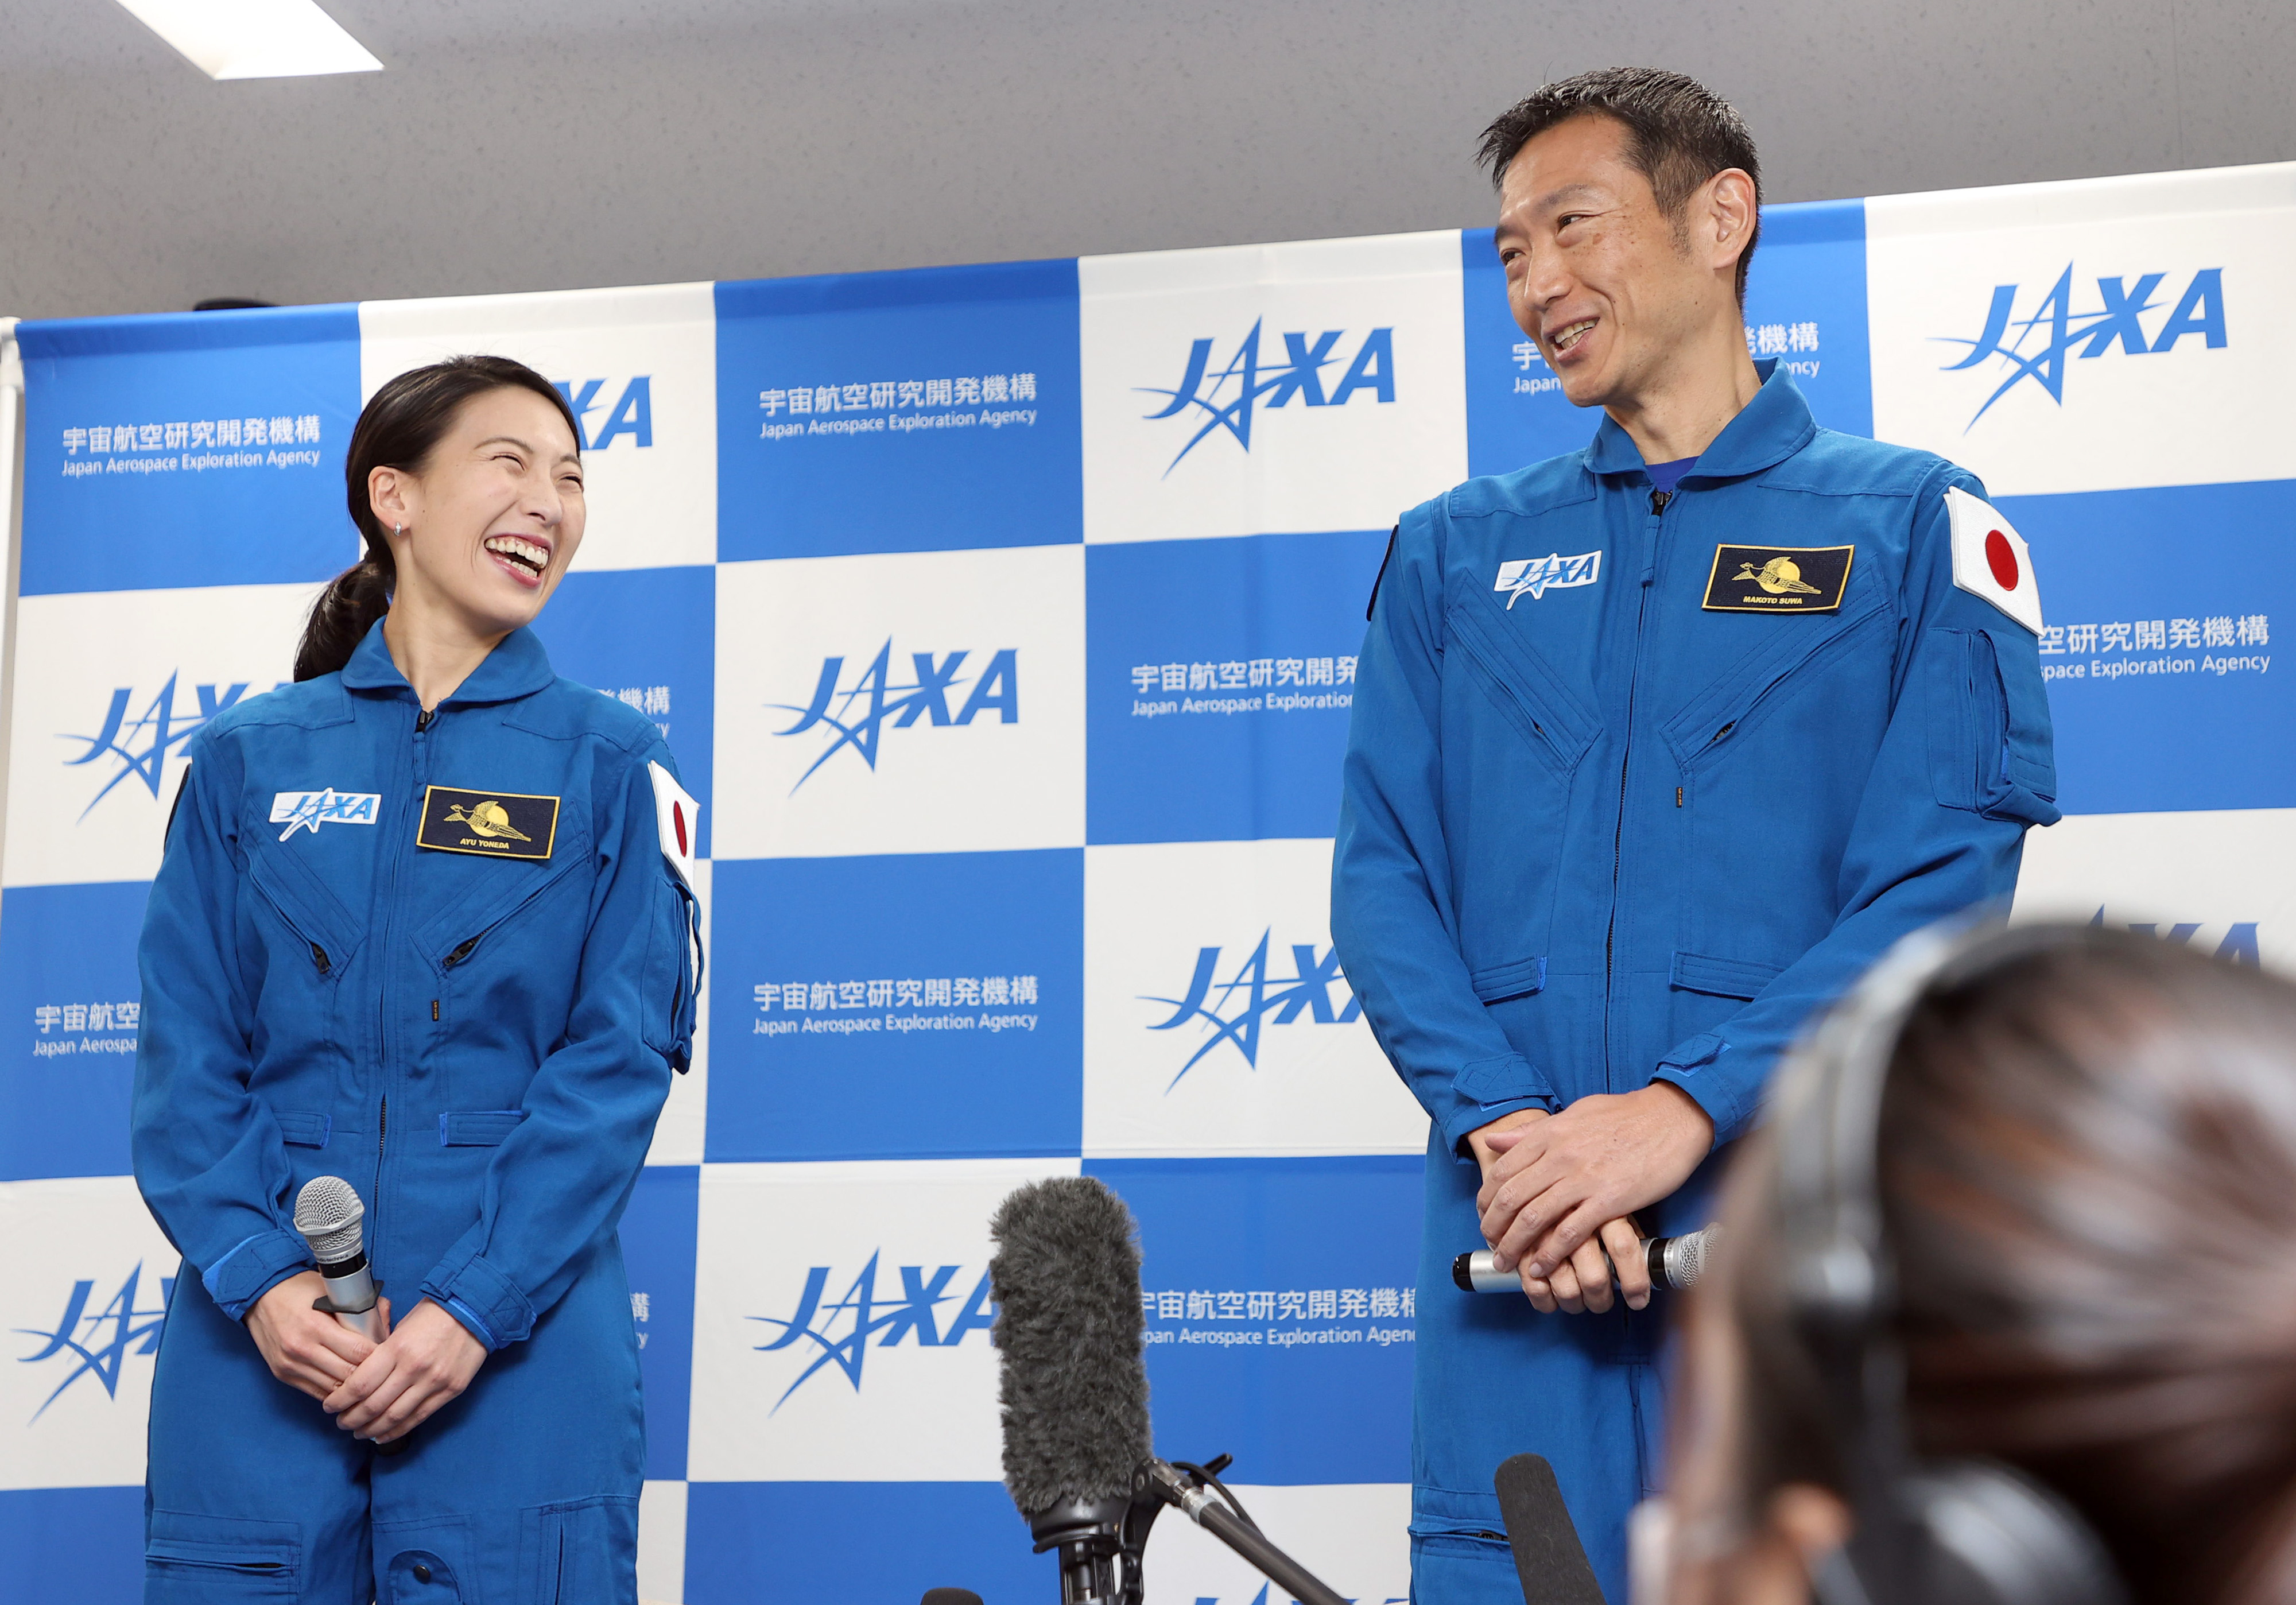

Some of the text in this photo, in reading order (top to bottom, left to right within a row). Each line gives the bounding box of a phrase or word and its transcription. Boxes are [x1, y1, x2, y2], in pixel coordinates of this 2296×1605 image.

[1925, 259, 2228, 437] JAXA
[1512, 377, 1561, 396] Japan
[1785, 360, 1820, 378] ncy
[552, 375, 652, 450] XA
[759, 373, 1037, 417] 宇宙航空研究開発機構
[1131, 313, 1396, 481] JAXA
[63, 414, 320, 455] 宇宙航空研究開発機構
[759, 409, 1037, 441] Japan Aerospace Exploration Agency
[62, 449, 321, 479] Japan Aerospace Exploration Agency
[1502, 555, 1597, 607] JAXA
[2038, 614, 2270, 655] 空研究開発機構
[1131, 656, 1358, 693] 宇宙航空研究開発
[2091, 656, 2196, 680] Exploration
[2201, 654, 2271, 676] Agency
[761, 634, 1019, 799] JAXA
[1131, 700, 1178, 718] Japan
[1181, 697, 1263, 715] Aerospace
[53, 666, 294, 825] JAX
[277, 791, 375, 839] JAXA
[460, 838, 510, 850] AYU YONEDA
[753, 975, 1038, 1012] 宇宙航空研究開発機構
[1135, 925, 1362, 1097] JAX
[753, 1013, 1038, 1037] Japan Aerospace Exploration Agency
[33, 1037, 137, 1059] Japan Aerospa
[8, 1256, 176, 1428] JA
[1141, 1326, 1415, 1348] pan Aerospace Exploration Agen
